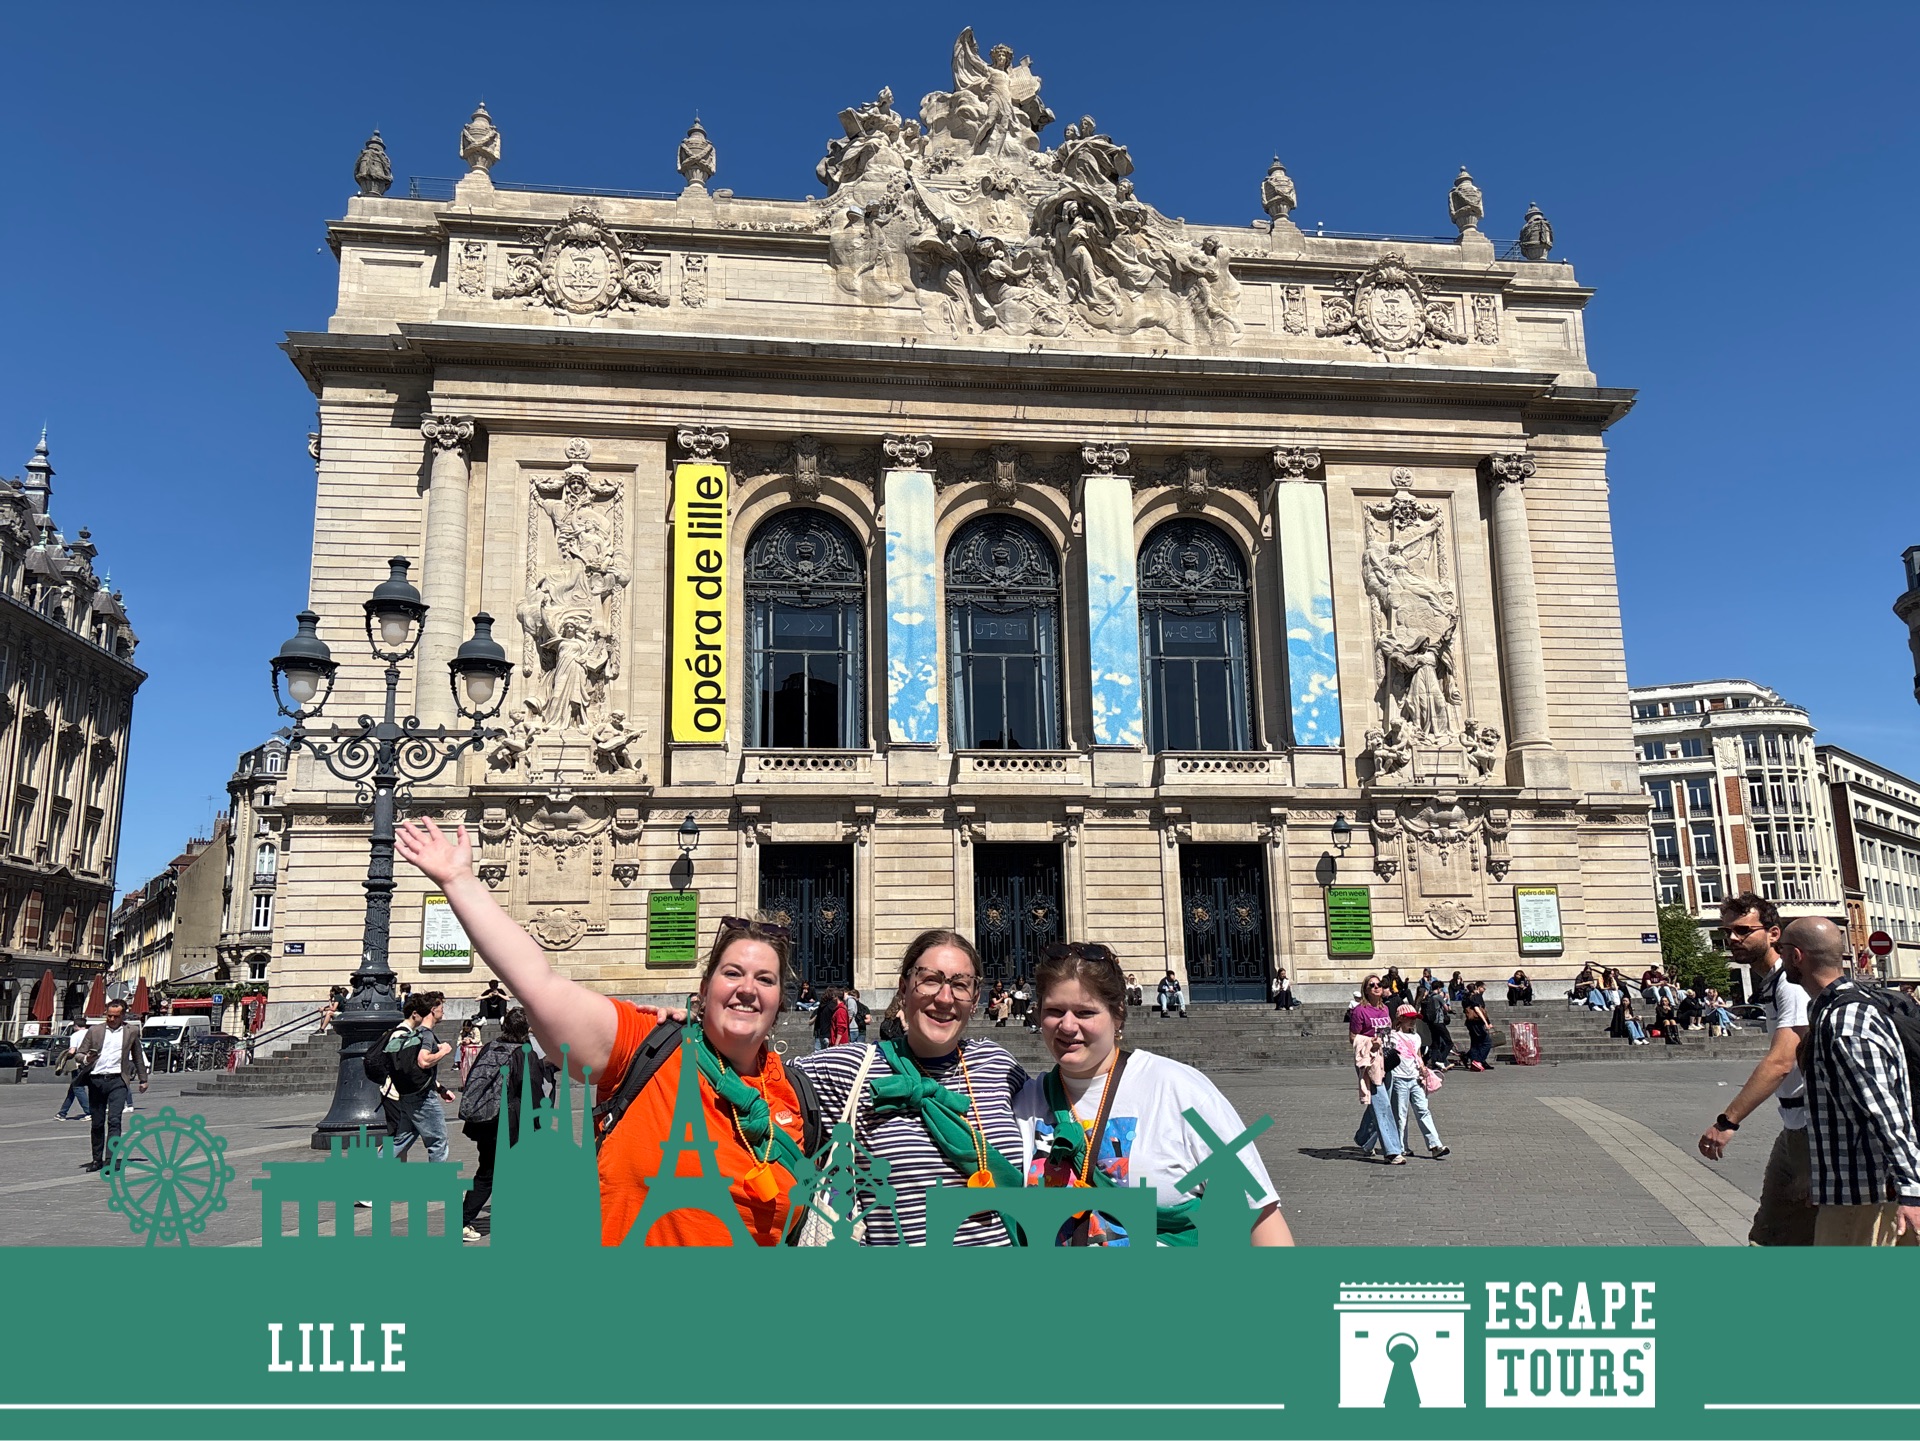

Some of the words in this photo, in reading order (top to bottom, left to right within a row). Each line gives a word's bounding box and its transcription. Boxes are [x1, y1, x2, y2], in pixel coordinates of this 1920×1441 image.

[687, 475, 723, 539] lille
[687, 549, 722, 600] de
[685, 609, 726, 733] opéra
[652, 895, 673, 903] open
[425, 941, 457, 951] saison
[1523, 928, 1550, 937] saison
